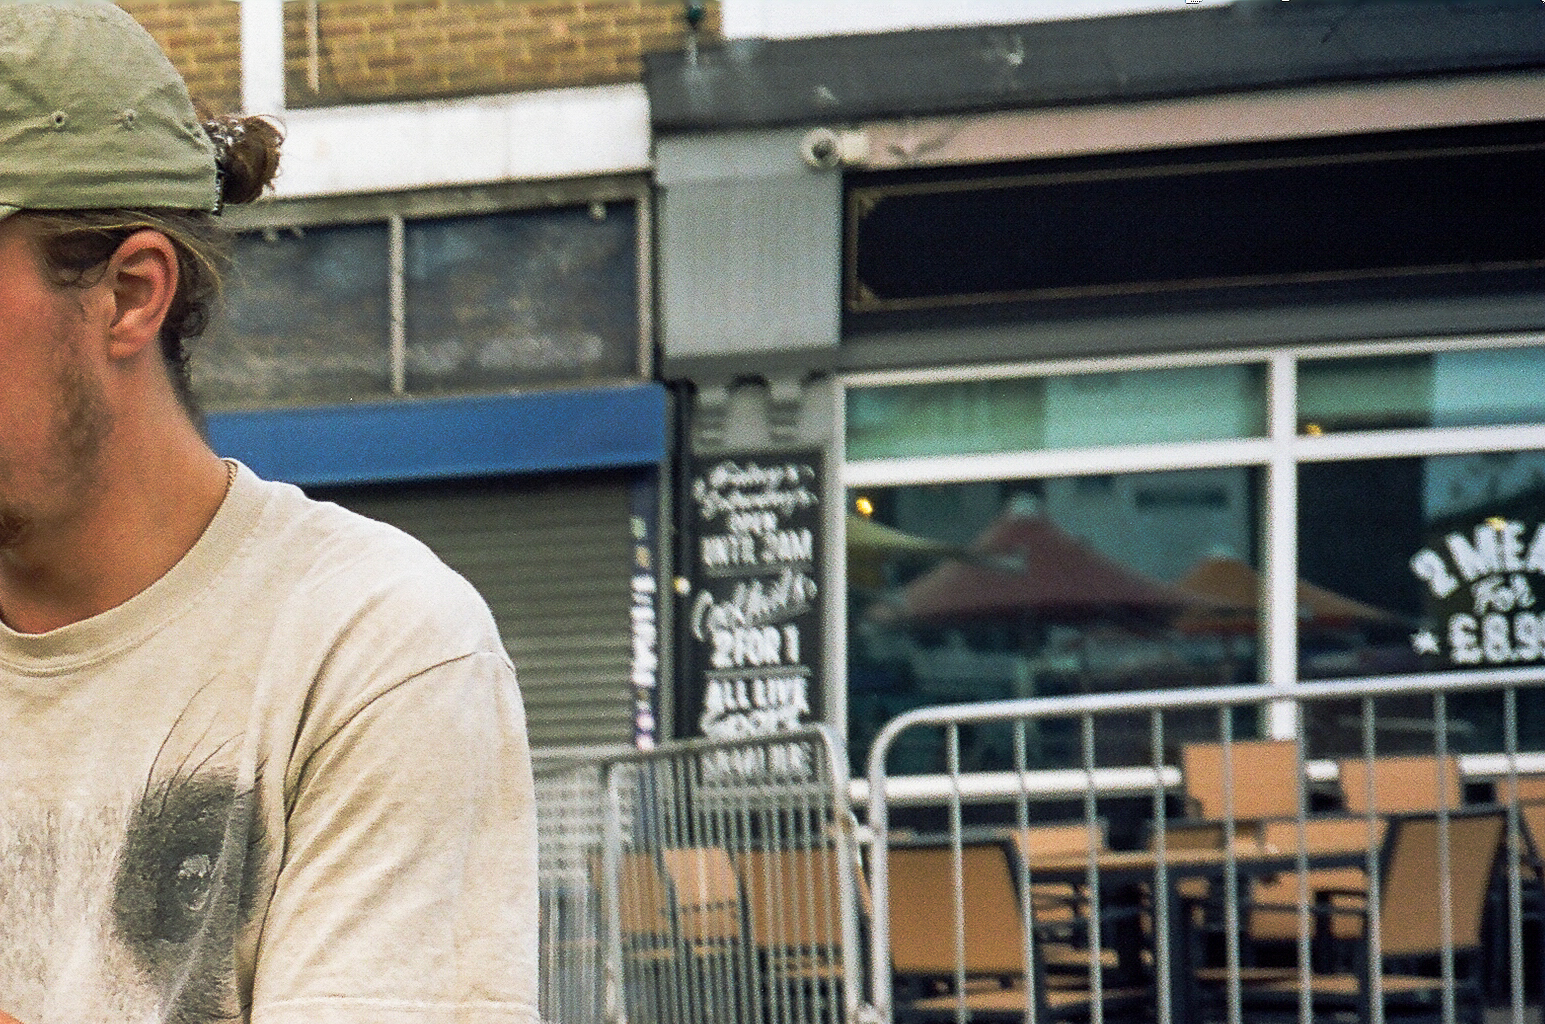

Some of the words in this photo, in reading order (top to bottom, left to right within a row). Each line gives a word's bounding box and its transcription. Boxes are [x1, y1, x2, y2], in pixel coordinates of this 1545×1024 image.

[733, 625, 781, 667] FOR
[706, 678, 751, 714] ALL
[752, 676, 811, 714] LIVE
